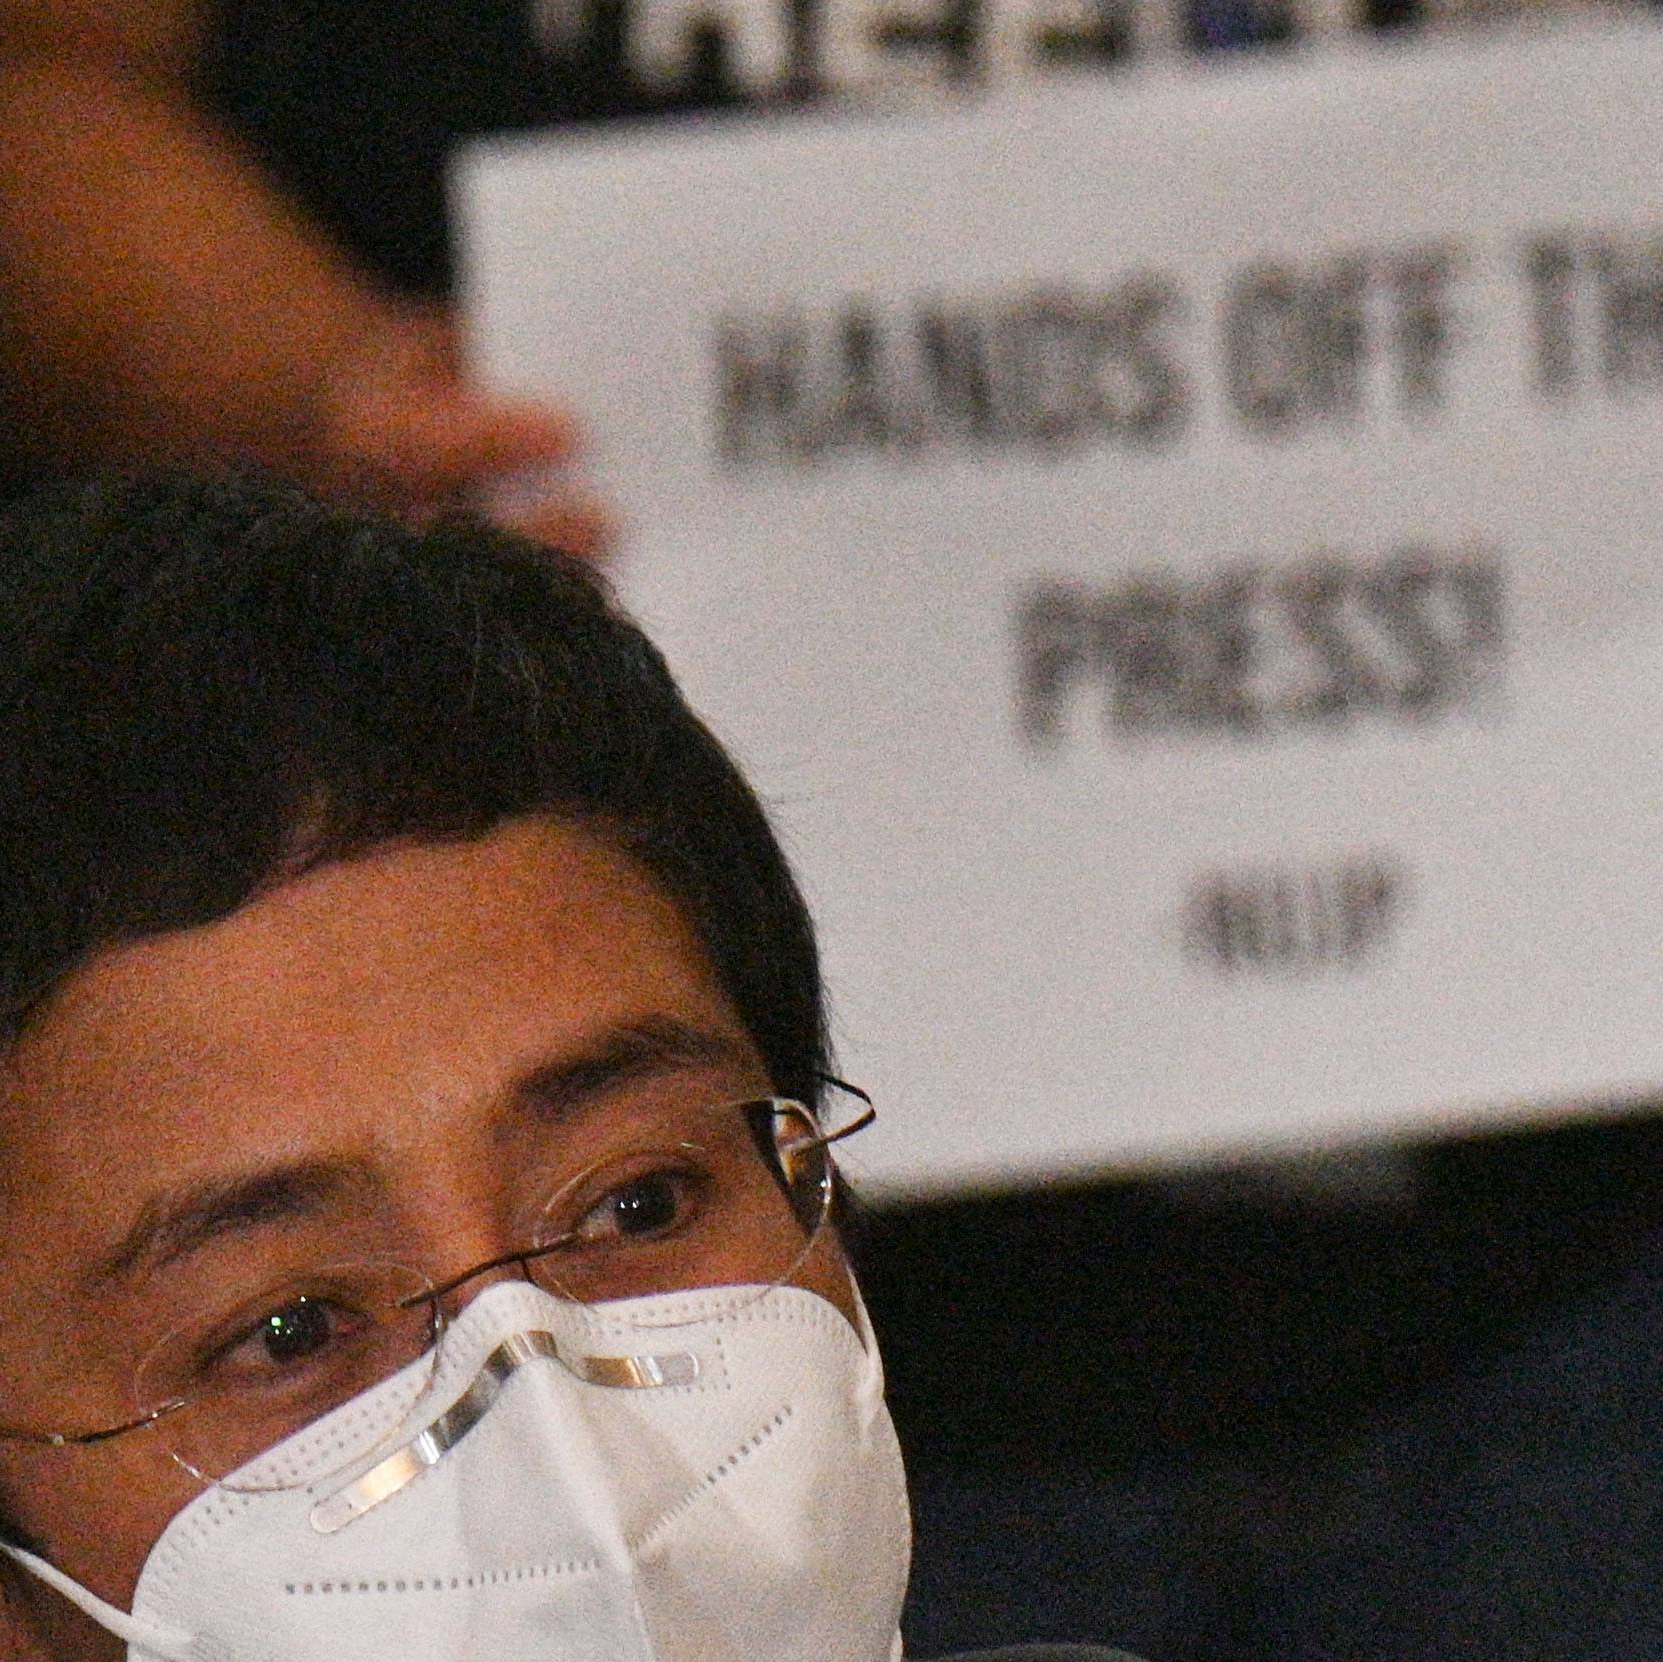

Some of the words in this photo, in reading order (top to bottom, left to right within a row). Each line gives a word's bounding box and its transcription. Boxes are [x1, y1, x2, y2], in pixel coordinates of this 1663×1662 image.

[716, 275, 1186, 472] HANDS
[1225, 242, 1462, 432] OFF
[1014, 546, 1502, 755] PRESS!
